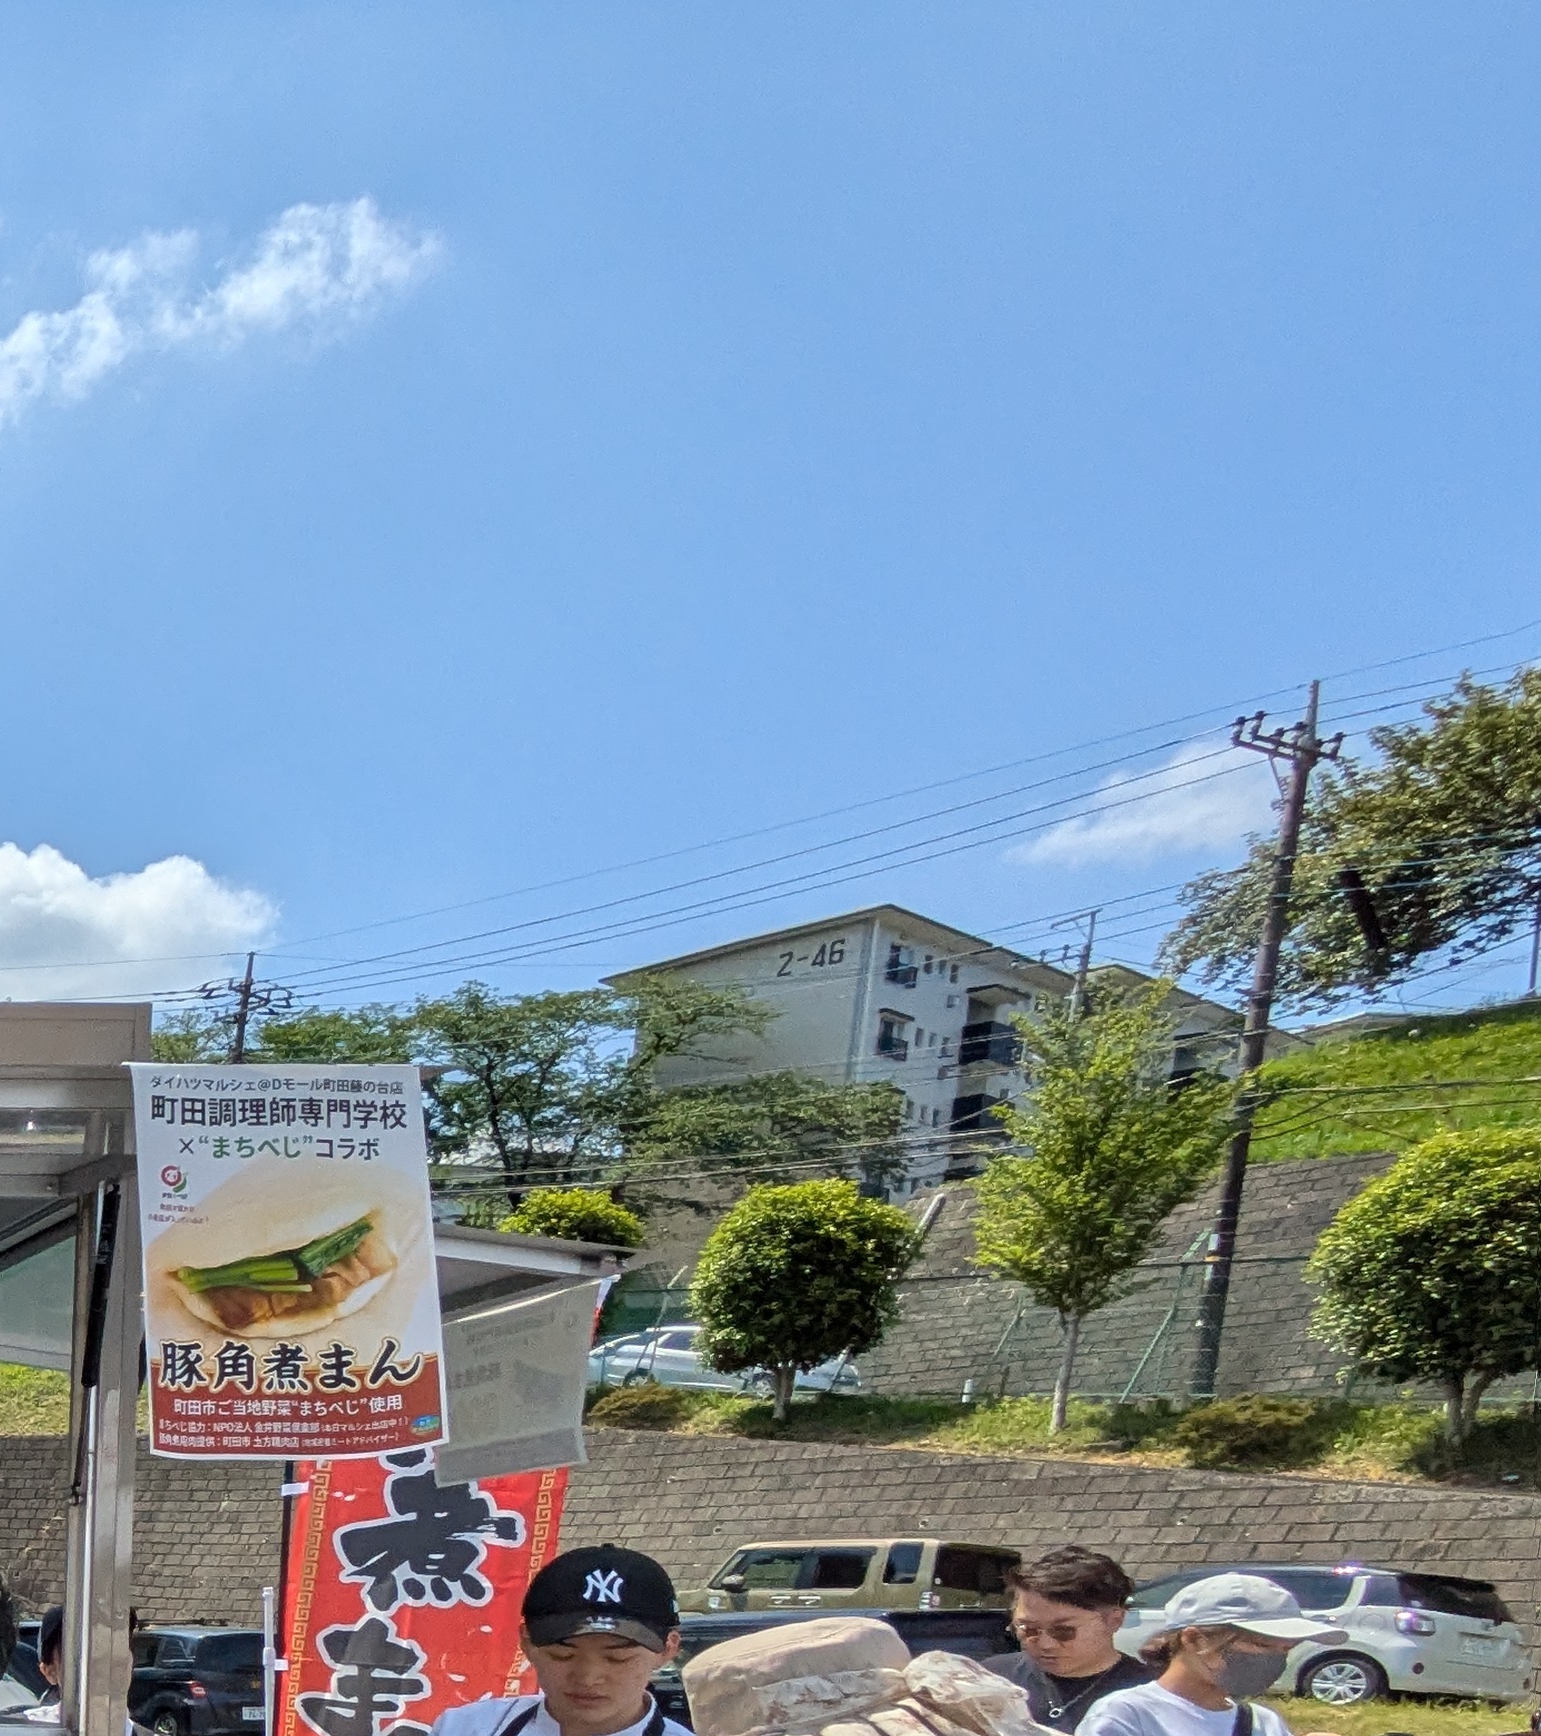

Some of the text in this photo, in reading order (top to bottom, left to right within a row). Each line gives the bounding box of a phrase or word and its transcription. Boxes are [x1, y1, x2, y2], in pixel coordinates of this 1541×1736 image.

[777, 938, 846, 977] 2-46
[150, 1095, 408, 1130] 町田調理師専門学校
[160, 1340, 420, 1392] 豚角煮まん
